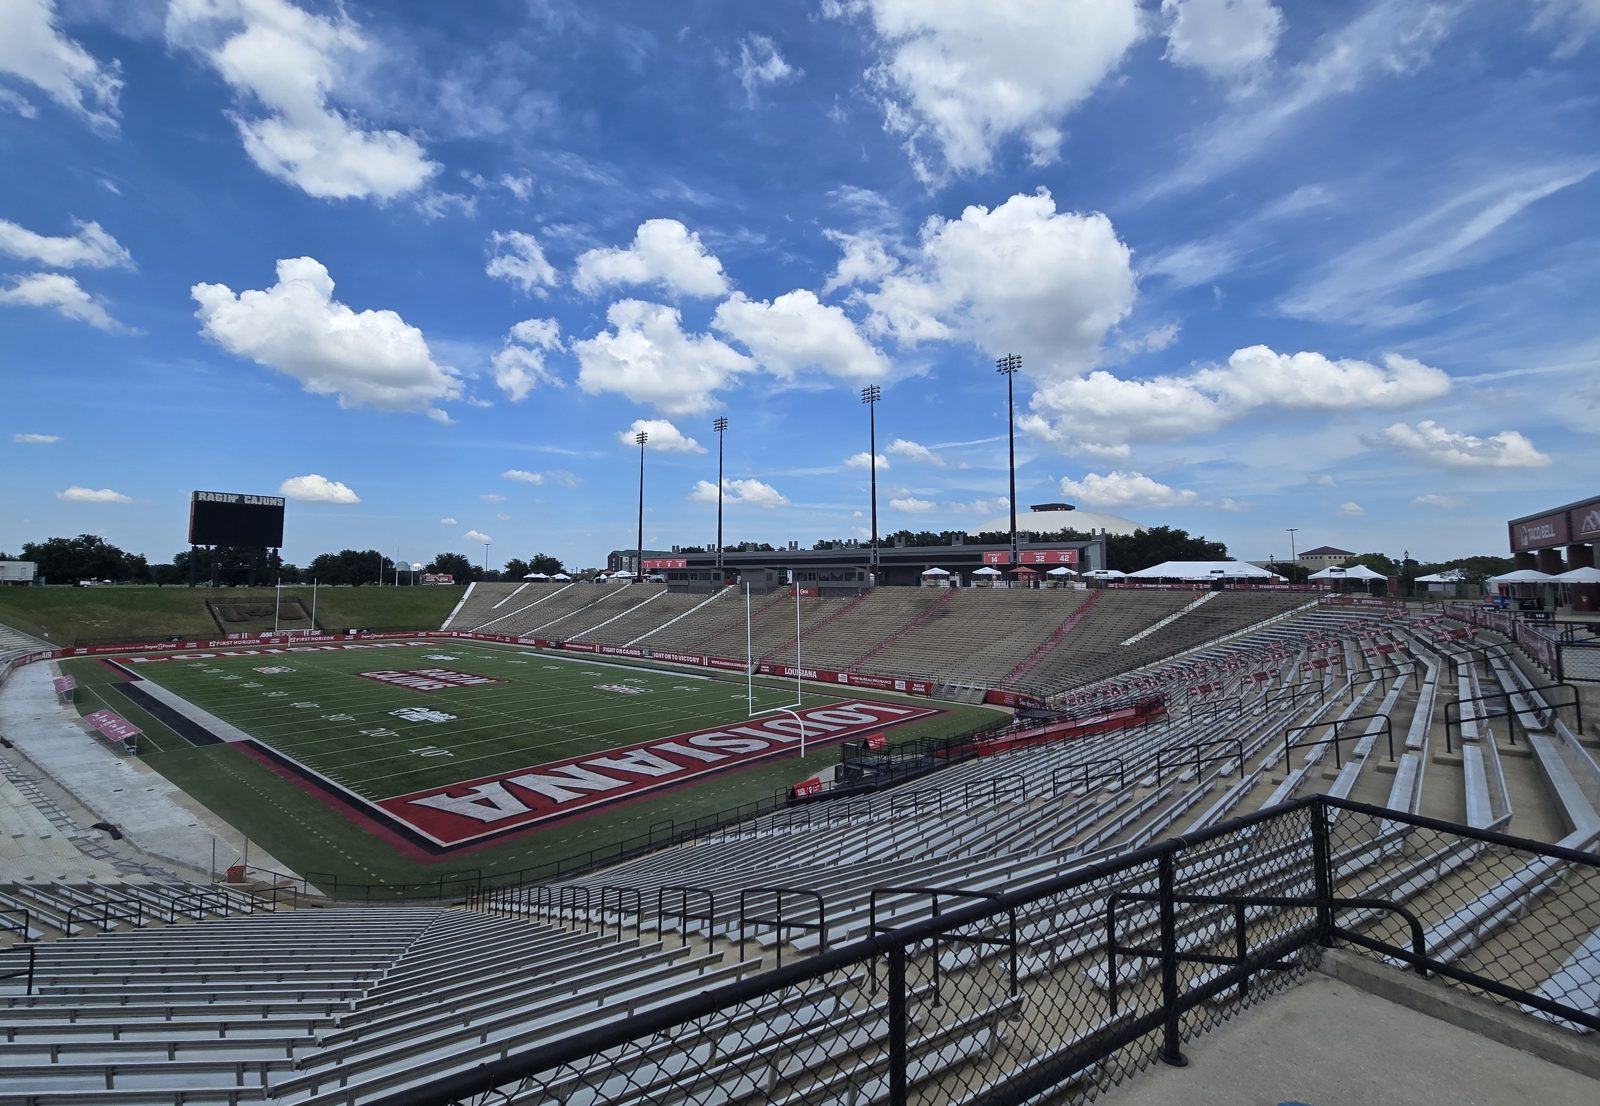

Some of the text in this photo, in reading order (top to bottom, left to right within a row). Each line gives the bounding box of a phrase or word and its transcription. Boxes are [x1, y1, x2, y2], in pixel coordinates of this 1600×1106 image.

[198, 492, 284, 506] RAGIN' CAJUNS
[1528, 523, 1555, 541] TACO BELL
[1059, 554, 1070, 562] 42
[678, 655, 700, 664] VICTORY
[784, 667, 817, 679] LOUISIANA
[407, 745, 450, 757] 10
[407, 703, 914, 825] LOUISIANA
